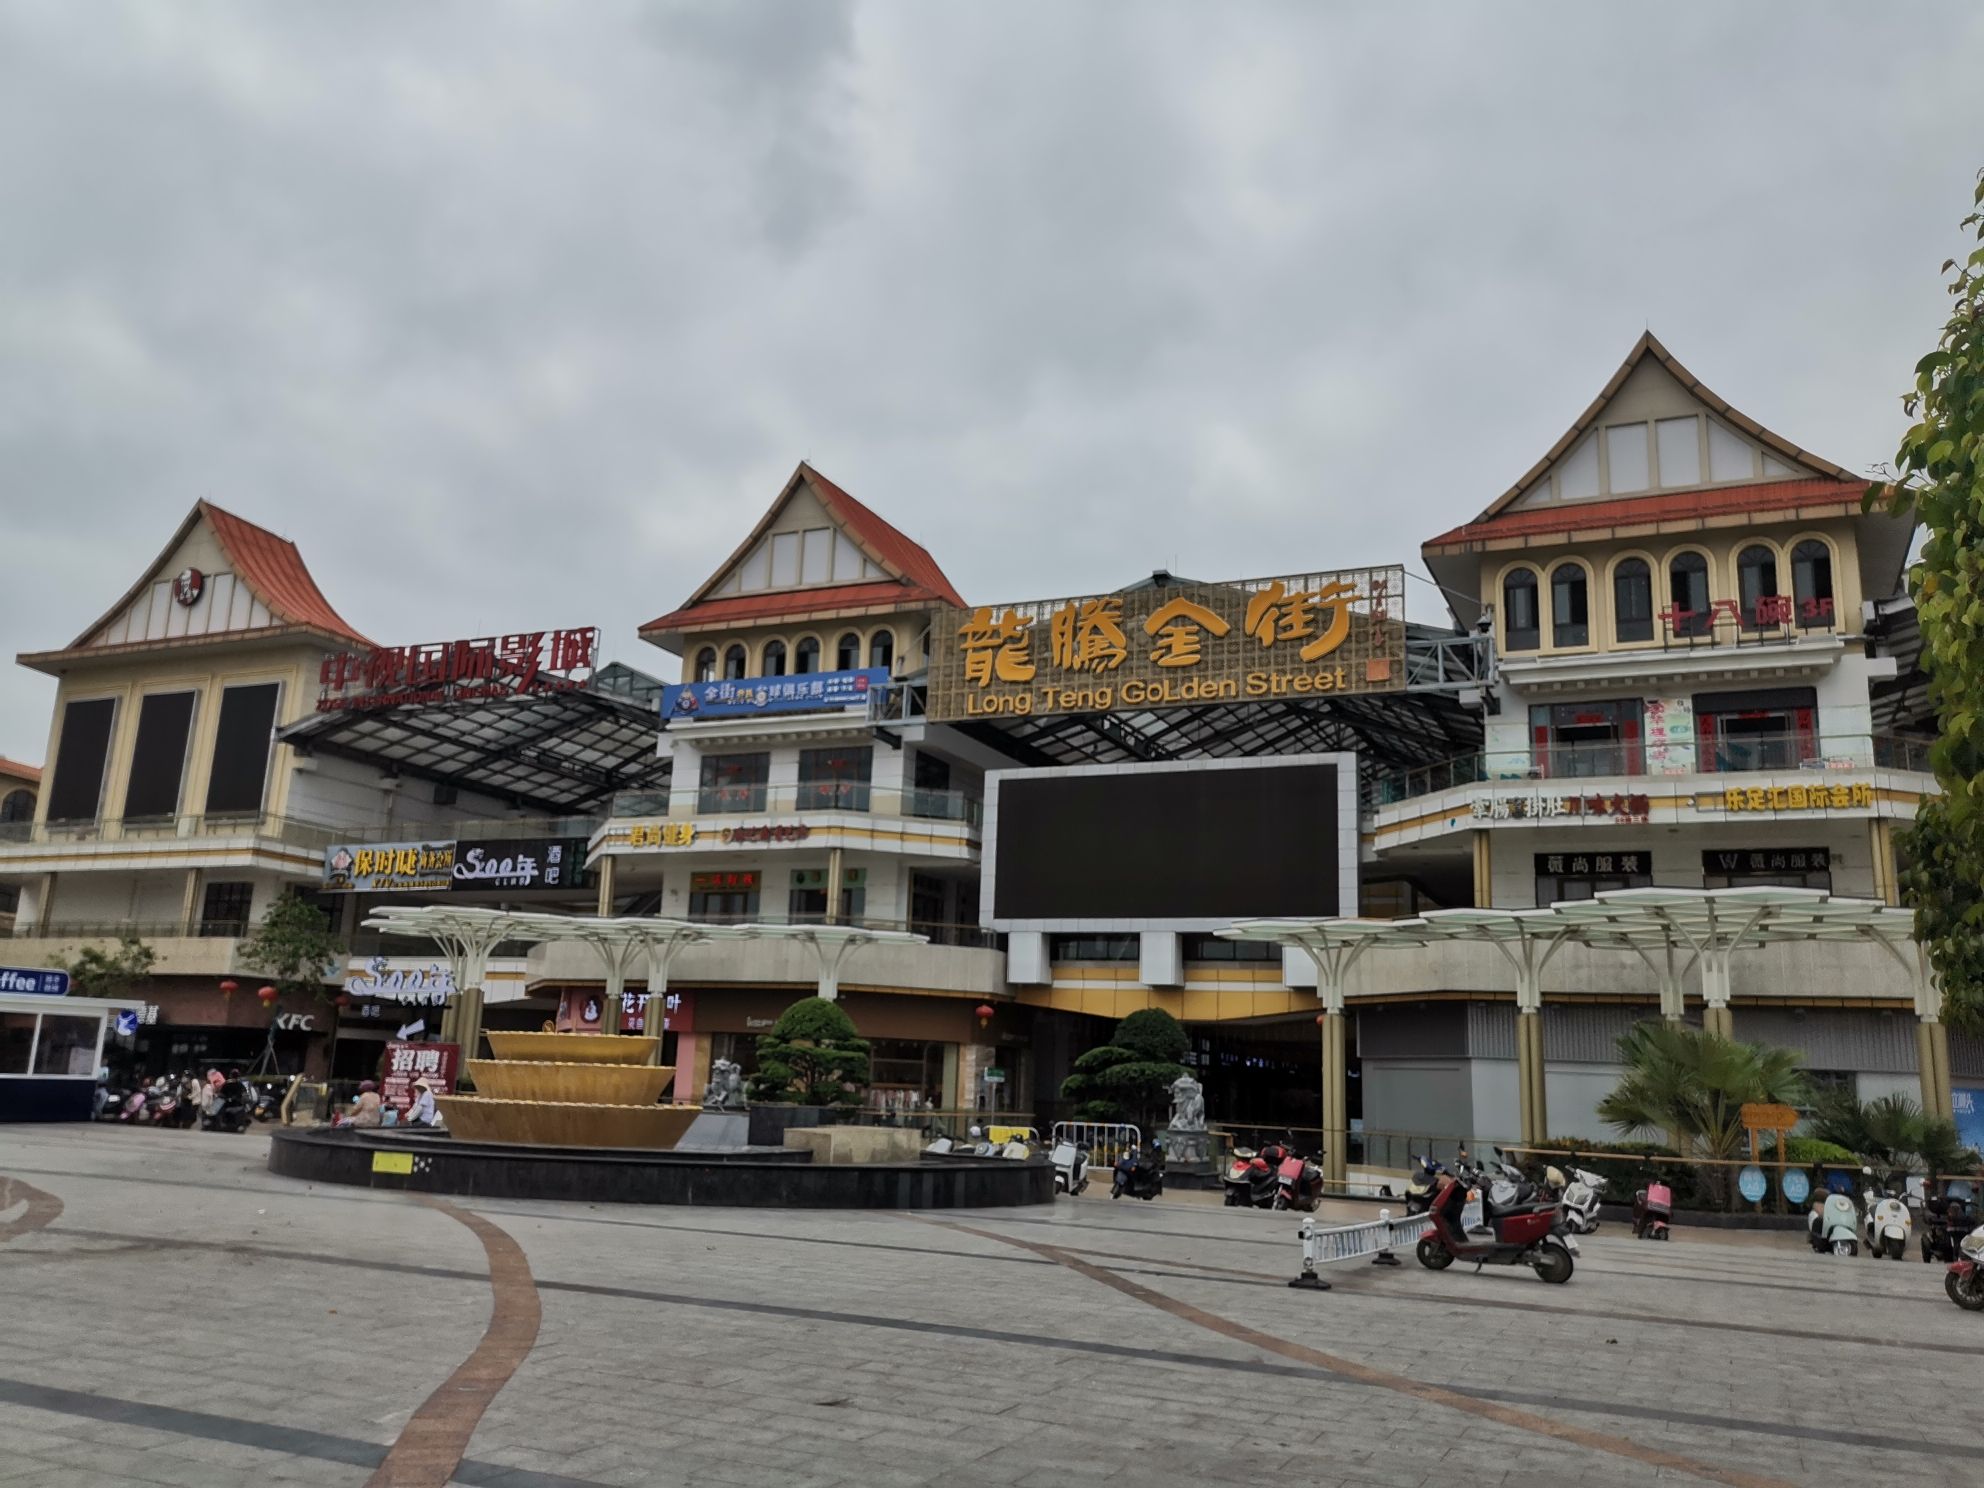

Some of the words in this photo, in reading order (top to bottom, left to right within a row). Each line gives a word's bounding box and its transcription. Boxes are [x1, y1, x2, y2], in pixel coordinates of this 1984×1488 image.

[1657, 594, 1793, 632] 十八碗
[967, 692, 1032, 715] Long
[1043, 685, 1112, 709] Teng
[1246, 666, 1346, 695] Street
[619, 991, 682, 1014] 花开叶
[276, 1012, 315, 1032] KFC
[391, 1048, 440, 1073] 招聘
